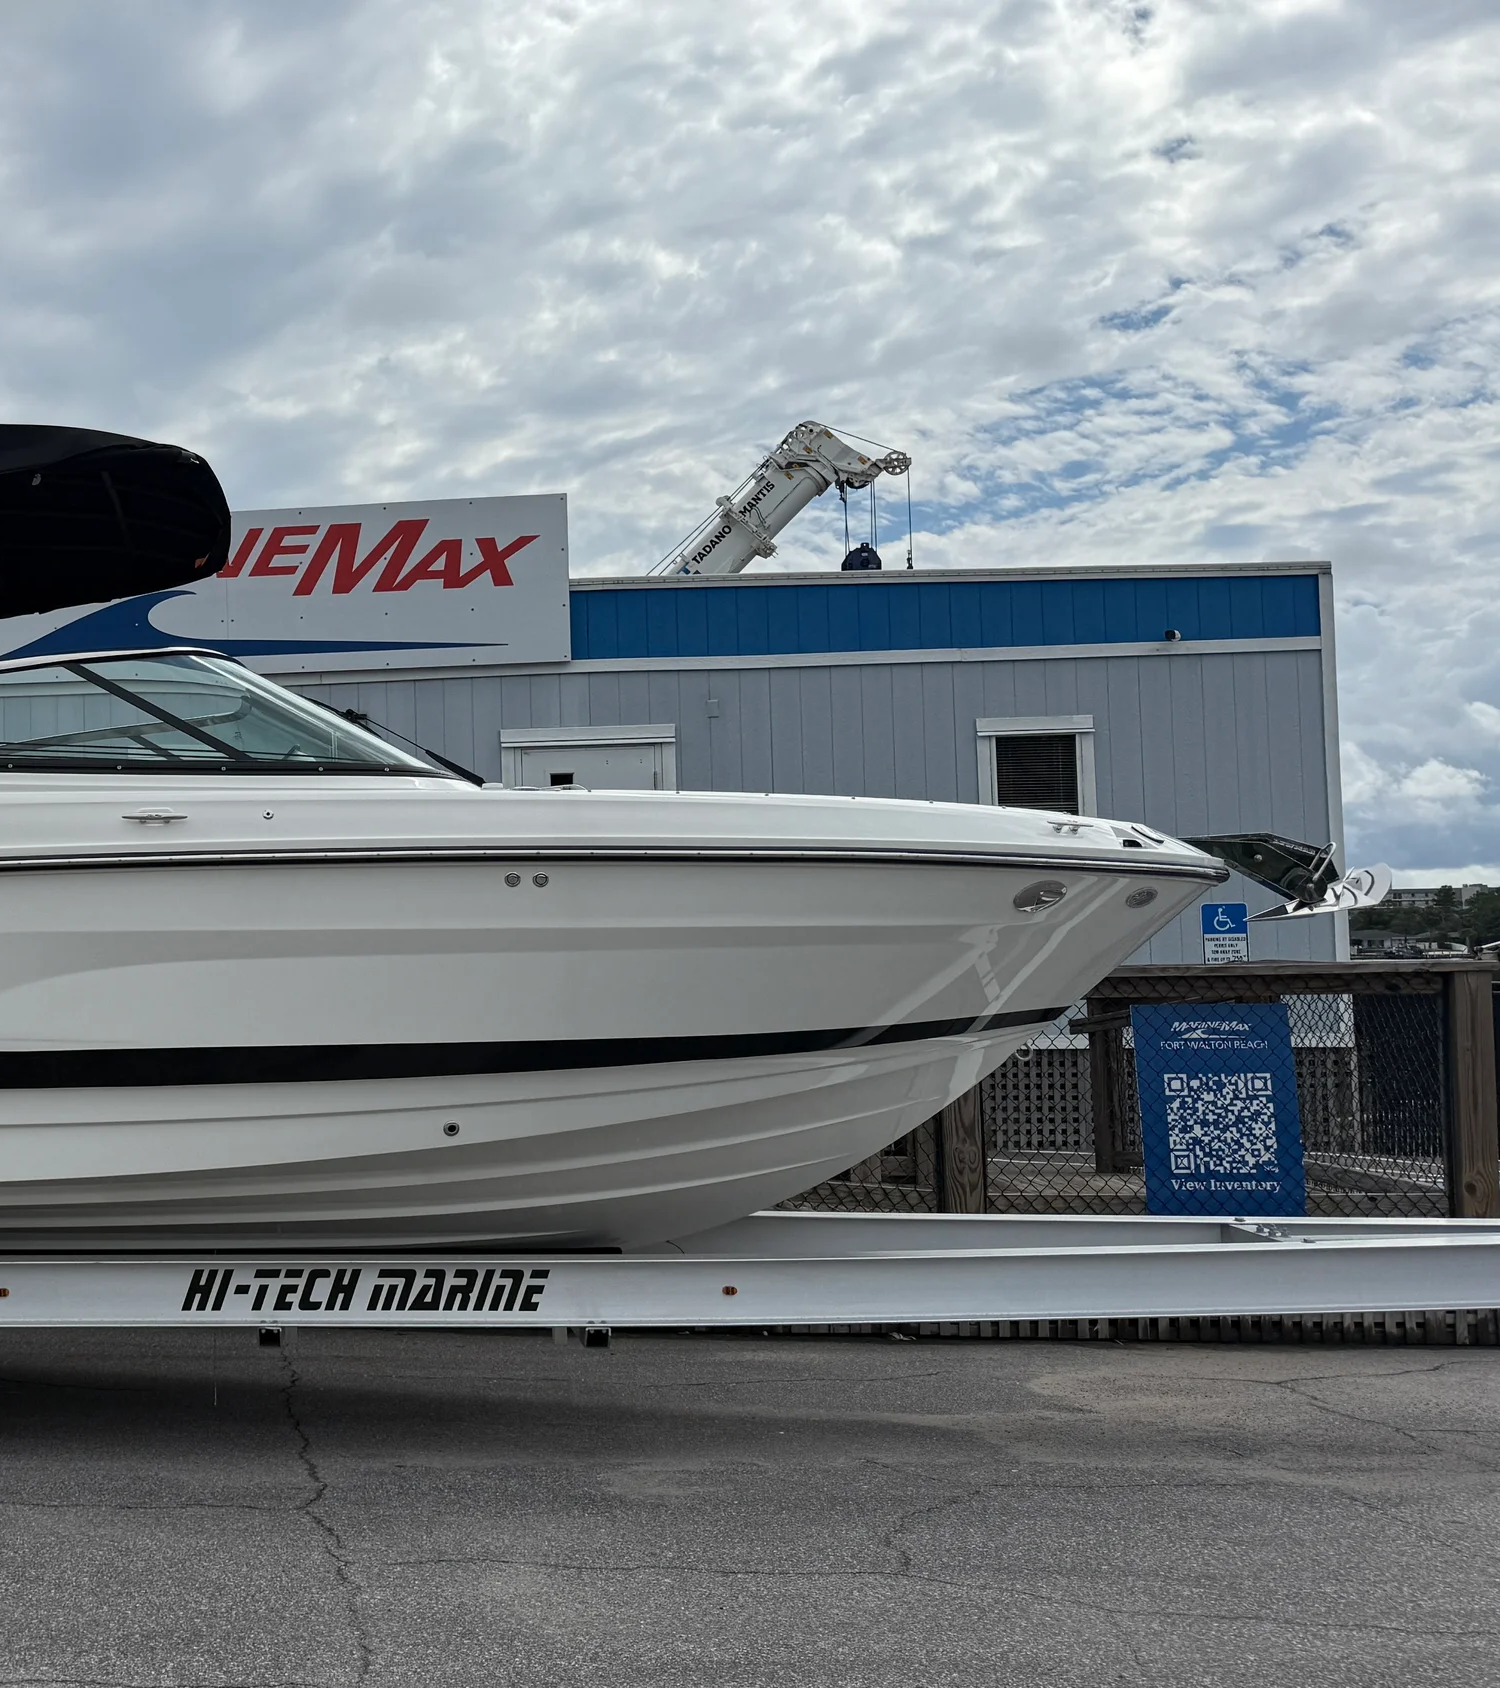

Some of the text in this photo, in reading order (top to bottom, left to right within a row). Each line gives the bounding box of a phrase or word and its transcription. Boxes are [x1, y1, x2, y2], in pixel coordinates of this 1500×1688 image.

[691, 480, 776, 565] TADANO MANTIS
[1160, 1040, 1268, 1050] FORT WALTON BEACH
[1171, 1179, 1281, 1193] View Inventory
[181, 1268, 551, 1312] HI-TECH MARINE
